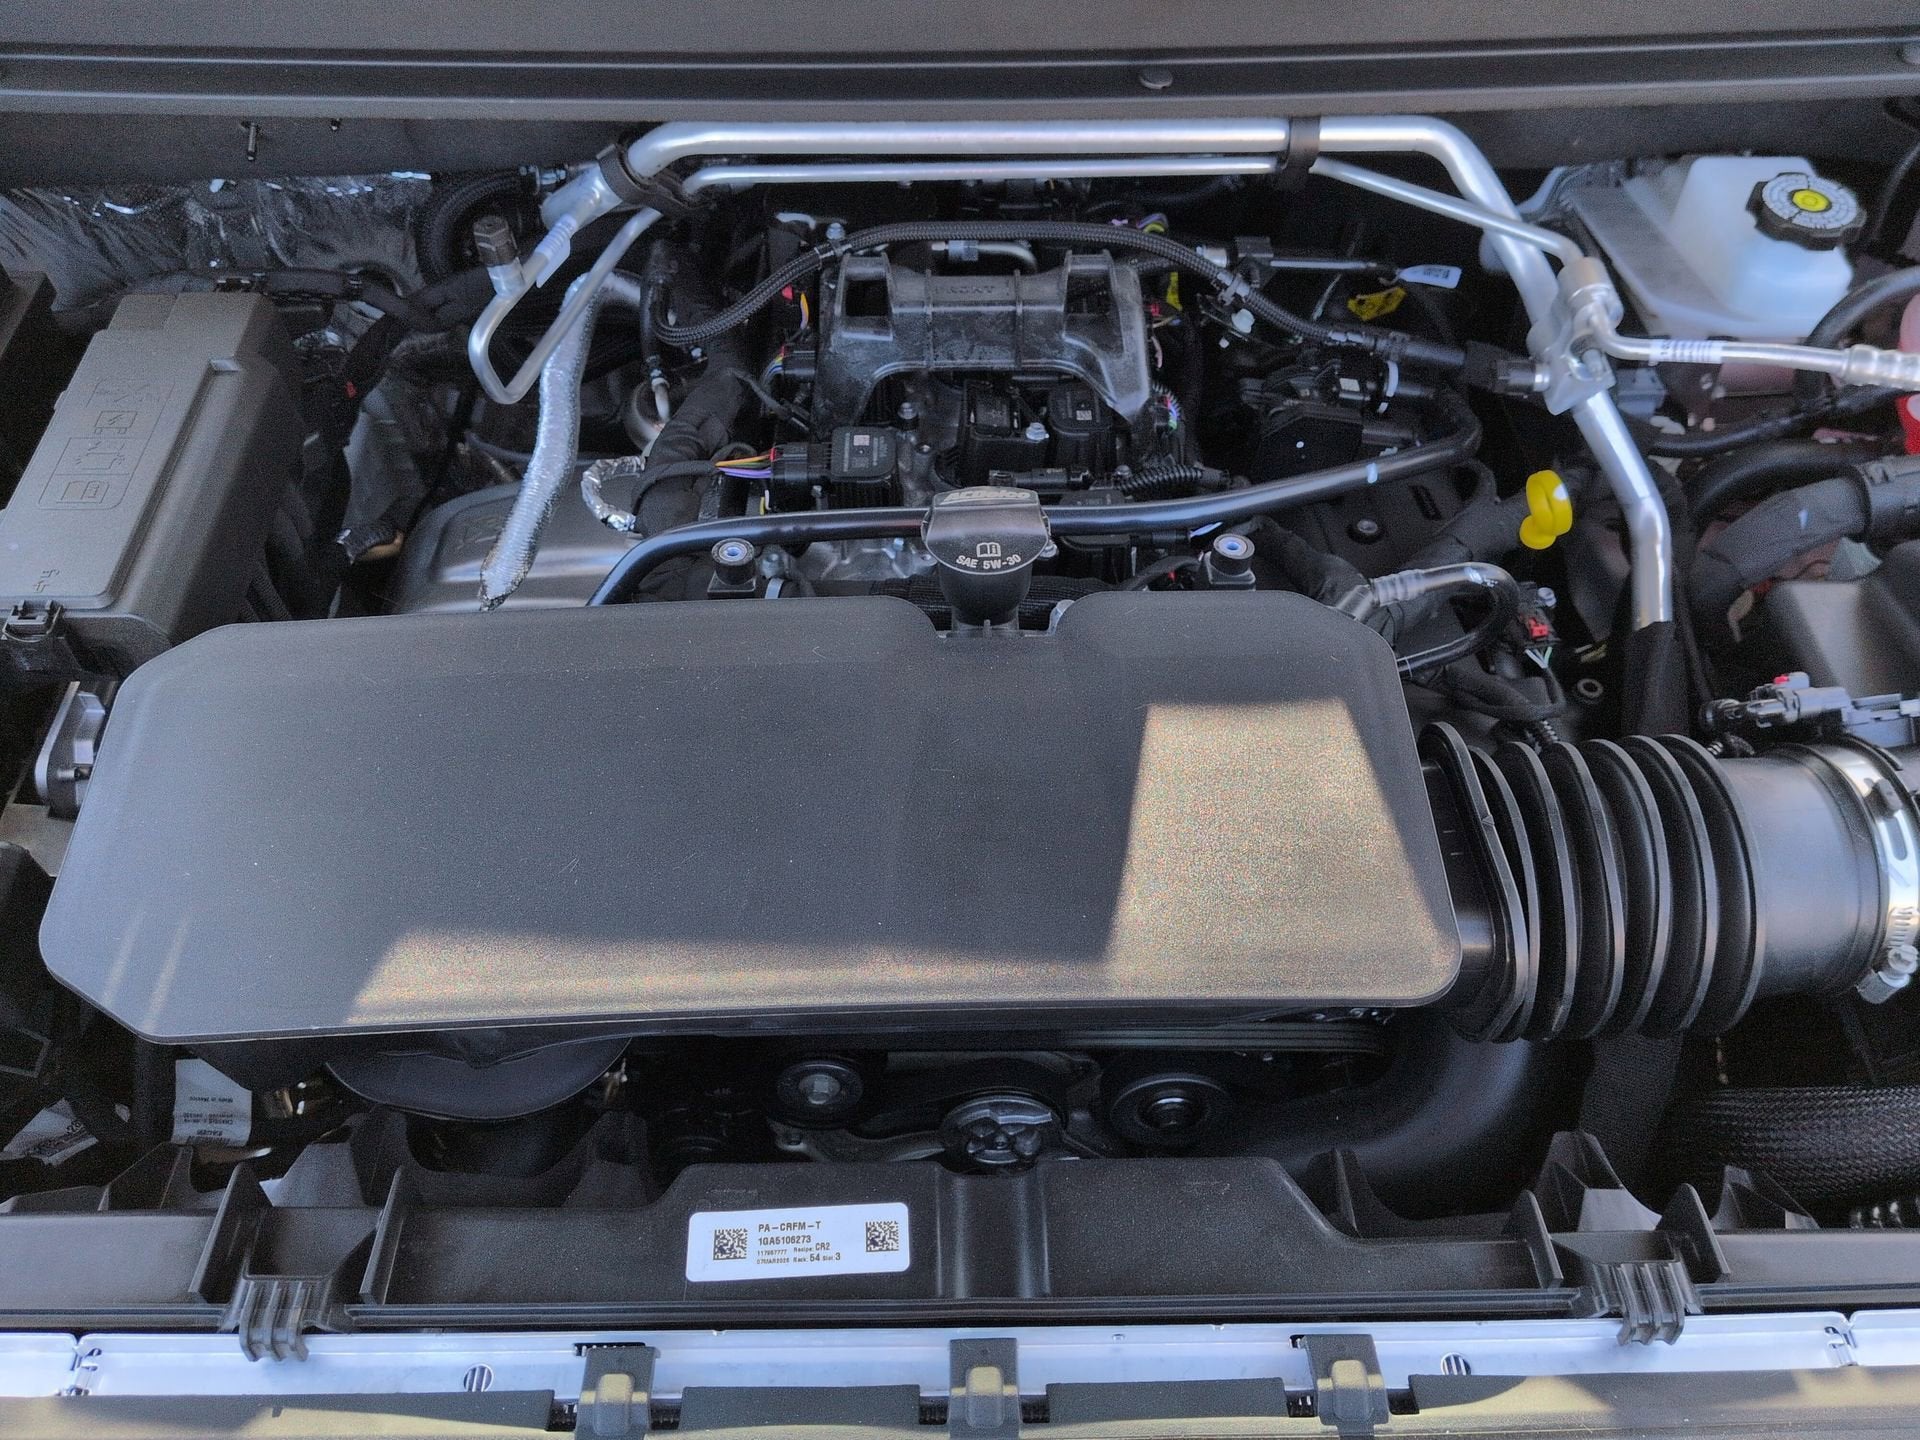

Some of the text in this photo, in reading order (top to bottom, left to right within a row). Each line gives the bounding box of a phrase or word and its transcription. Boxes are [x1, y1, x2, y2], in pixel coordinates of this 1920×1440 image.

[956, 554, 1021, 569] SAE 5W-30
[758, 1220, 821, 1233] PA-CRFM-T
[815, 1242, 830, 1251] CR2
[809, 1253, 820, 1262] 54
[835, 1252, 841, 1261] 3
